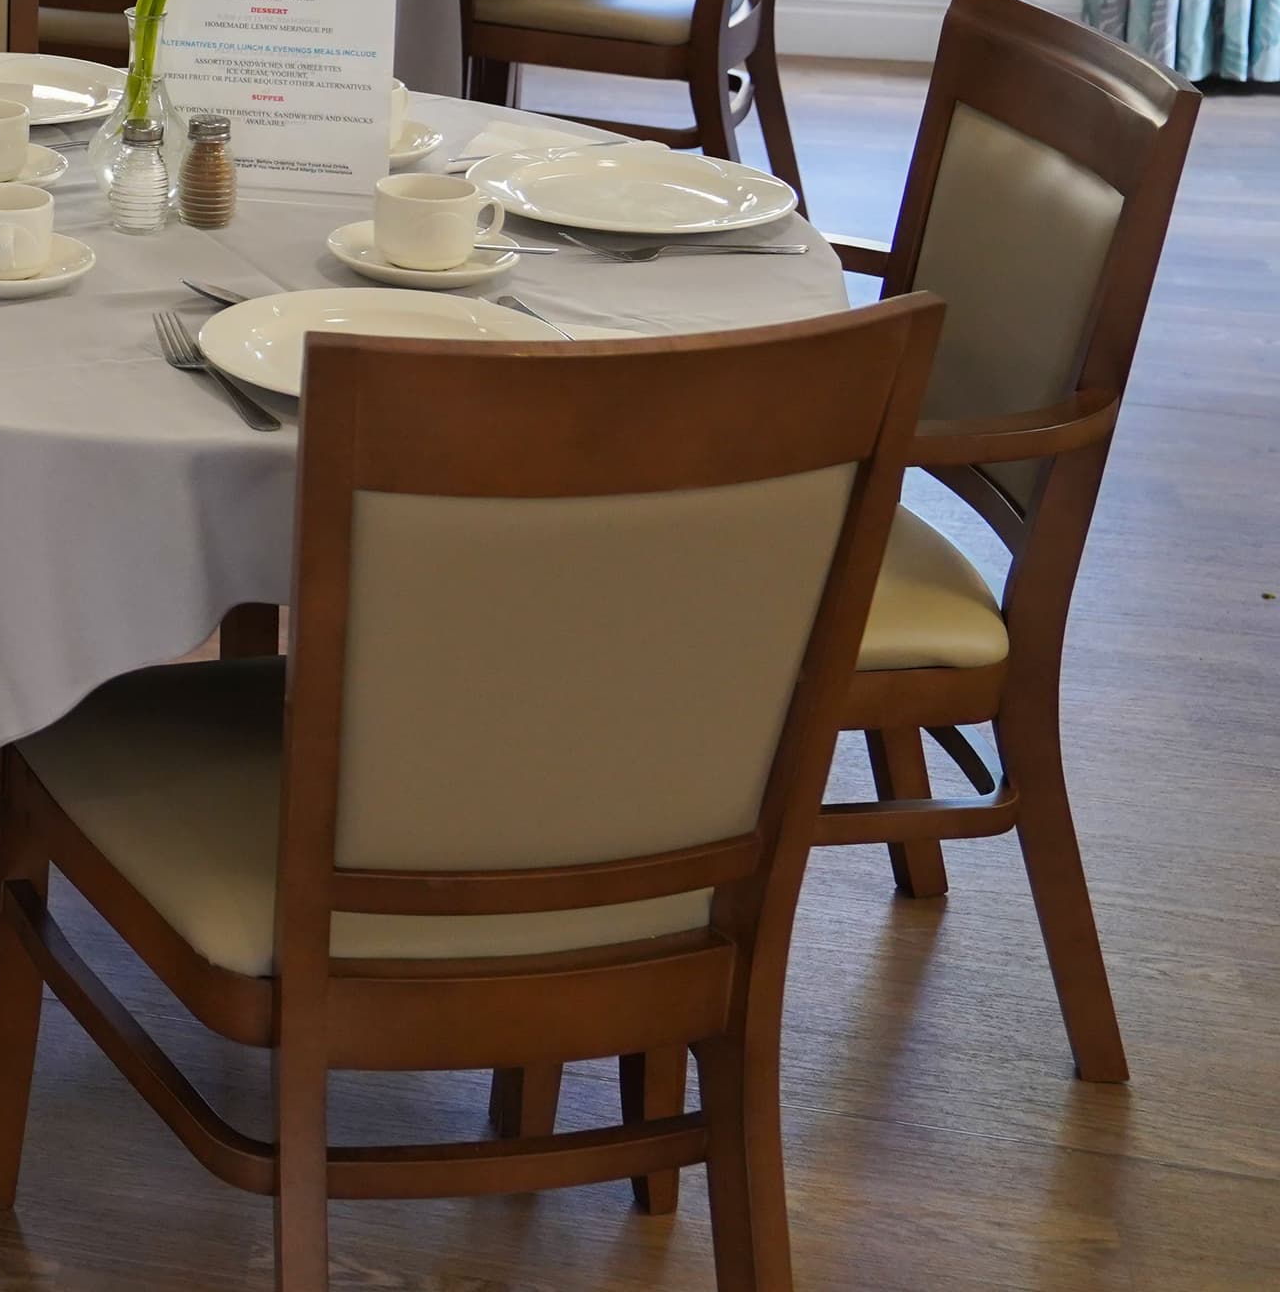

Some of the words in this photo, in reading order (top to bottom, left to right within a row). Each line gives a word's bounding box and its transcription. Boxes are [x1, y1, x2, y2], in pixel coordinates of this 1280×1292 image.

[250, 6, 288, 15] DESSERT
[205, 20, 249, 29] HOMEMADE
[251, 23, 278, 31] LEMON
[279, 25, 320, 34] MERINGUE
[321, 27, 333, 35] PIE
[161, 38, 217, 49] ALTERNATIVES
[219, 42, 235, 50] FOR
[237, 43, 263, 51] LUNCH
[273, 46, 312, 54] EVENINGS
[342, 49, 376, 58] INCLUDE
[195, 58, 233, 66] ASSORTED
[233, 60, 283, 68] SANDWICHES
[297, 63, 342, 72] OMELETTES
[225, 75, 253, 84] PLEASE
[254, 77, 288, 86] REQUEST
[289, 79, 314, 87] OTHER
[316, 81, 372, 91] ALTERNATIVES
[251, 94, 285, 102] SUPPER
[245, 118, 285, 127] AVAILABLE
[273, 111, 324, 121] SANDWICHES
[325, 114, 341, 122] AND
[342, 116, 374, 124] SNACKS
